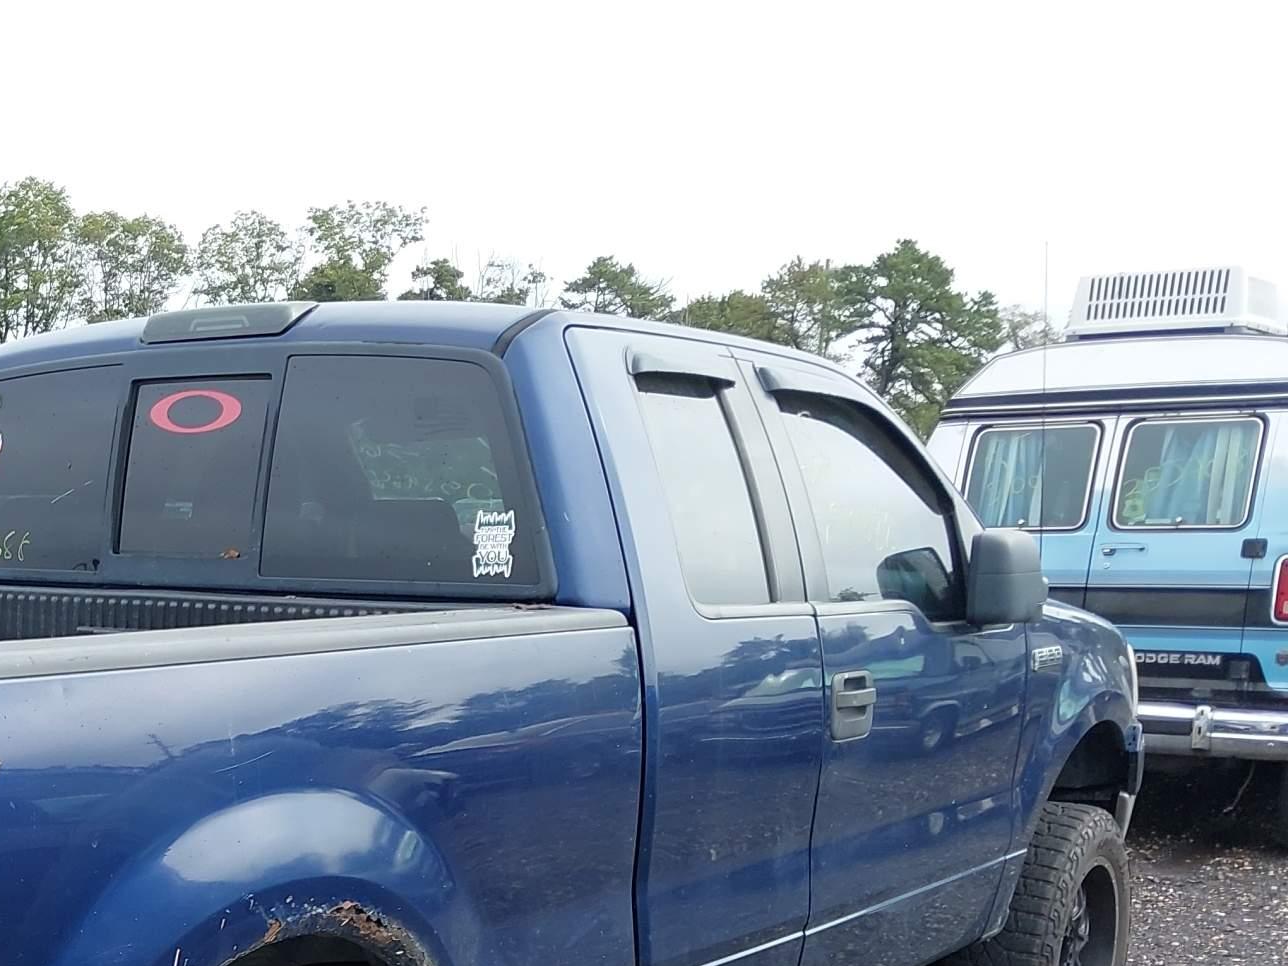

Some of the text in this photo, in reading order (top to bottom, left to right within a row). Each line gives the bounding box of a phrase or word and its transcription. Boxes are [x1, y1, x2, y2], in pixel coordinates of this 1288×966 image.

[476, 533, 512, 543] FOREST
[478, 550, 508, 563] YOU
[1184, 653, 1222, 666] RAM
